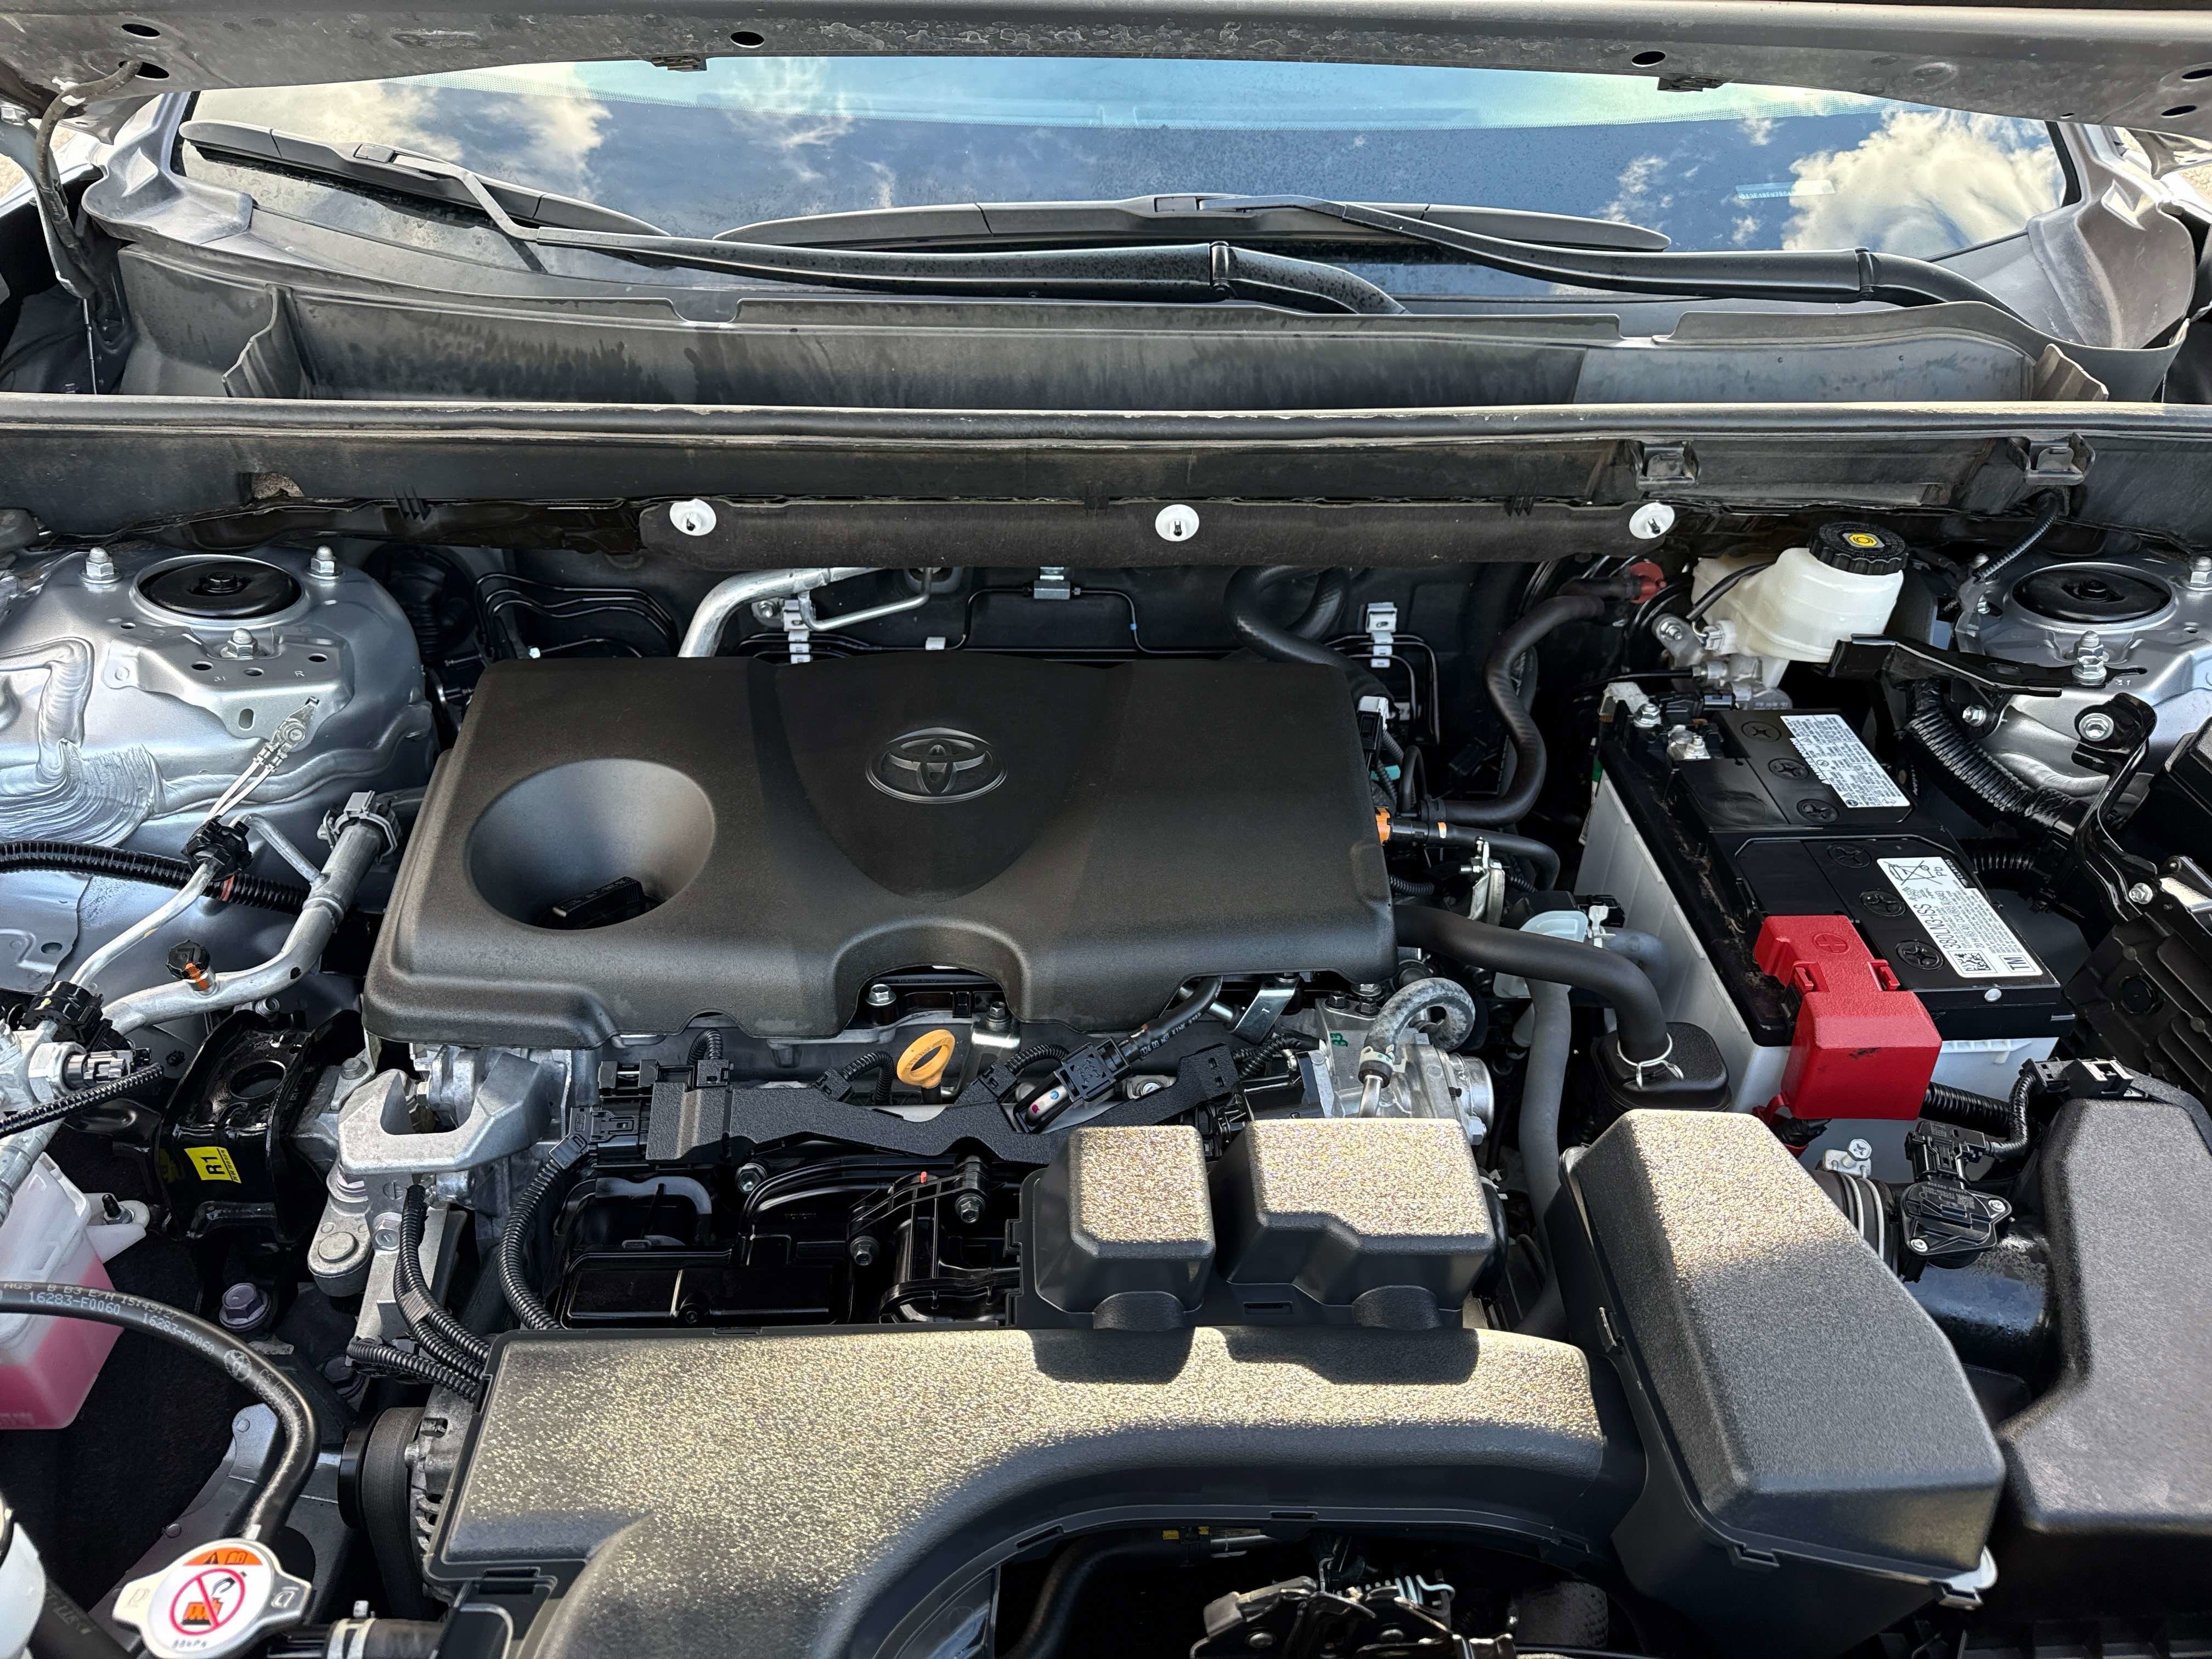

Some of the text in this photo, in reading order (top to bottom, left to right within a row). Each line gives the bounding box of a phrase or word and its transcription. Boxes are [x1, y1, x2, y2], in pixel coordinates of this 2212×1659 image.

[1933, 866, 1948, 876] Pb
[1912, 904, 1962, 949] 380LN3-ISS
[2004, 957, 2030, 970] TM
[200, 1156, 225, 1175] R1
[29, 1291, 216, 1356] 16283-F0060 16283-F0060
